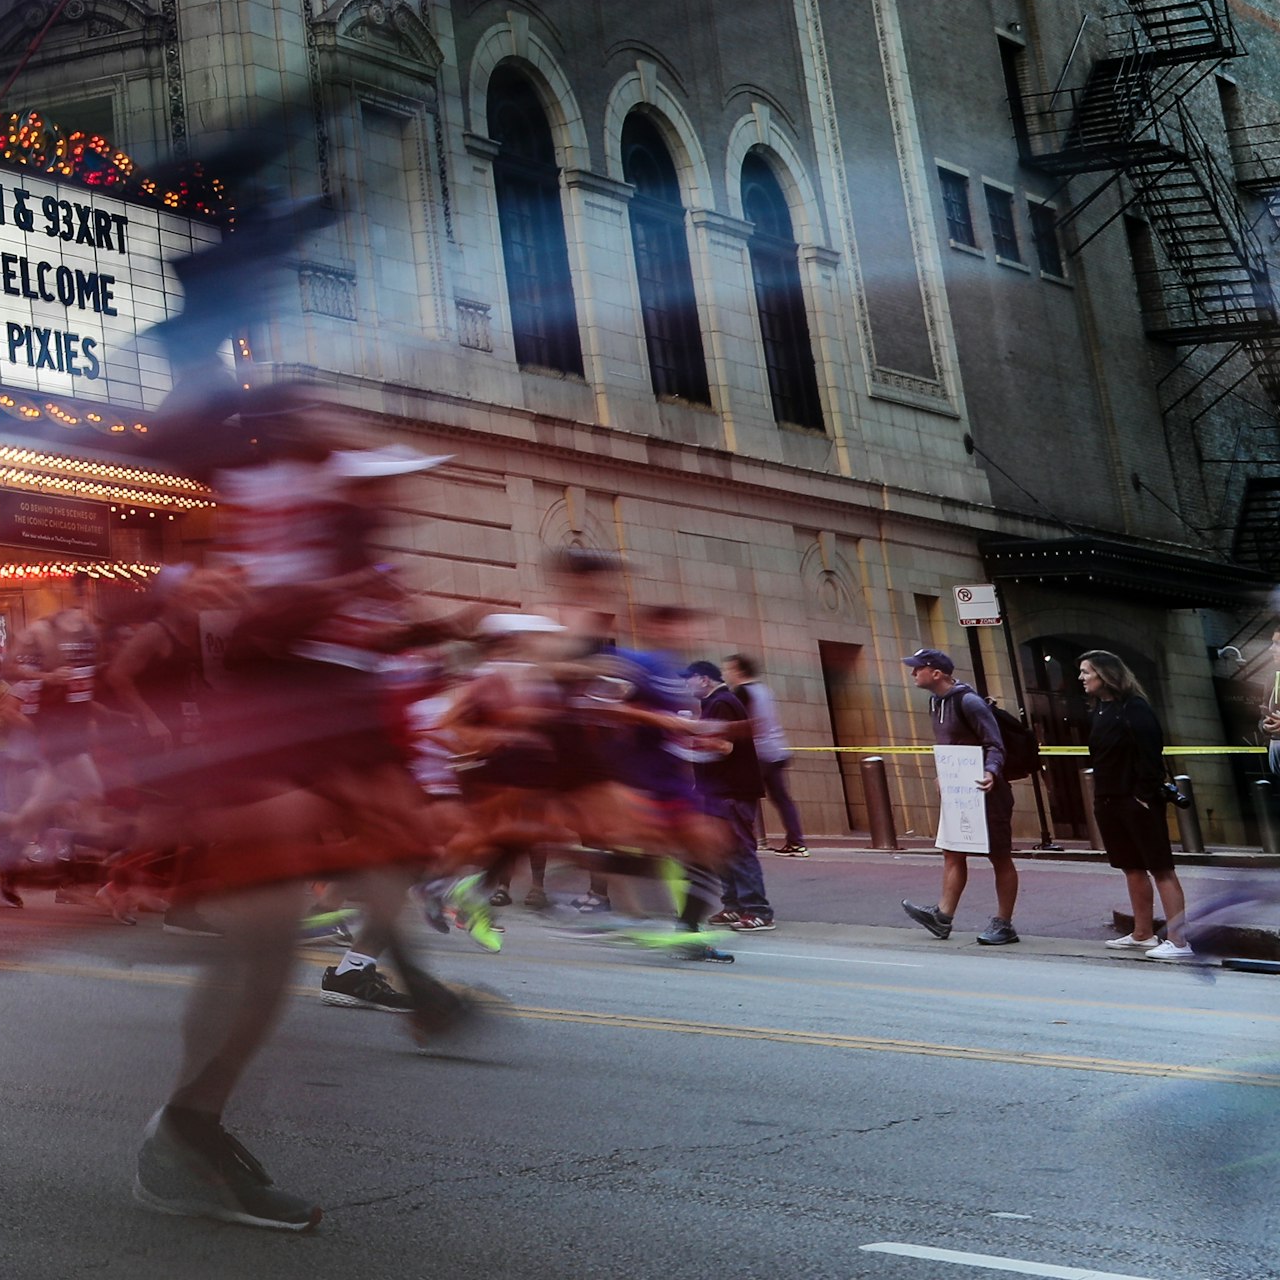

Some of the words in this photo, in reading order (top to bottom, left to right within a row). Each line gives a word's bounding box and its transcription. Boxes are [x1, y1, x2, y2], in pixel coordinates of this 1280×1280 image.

[13, 187, 35, 233] &
[42, 195, 129, 255] 93XRT
[6, 321, 100, 380] PIXIES
[14, 514, 26, 524] THE
[27, 516, 48, 528] ICONIC
[48, 519, 76, 531] CHICAGO
[20, 502, 30, 511] GO
[30, 504, 53, 515] BEHIND
[54, 507, 66, 517] THE
[66, 509, 88, 520] SCENES
[88, 512, 97, 521] OF
